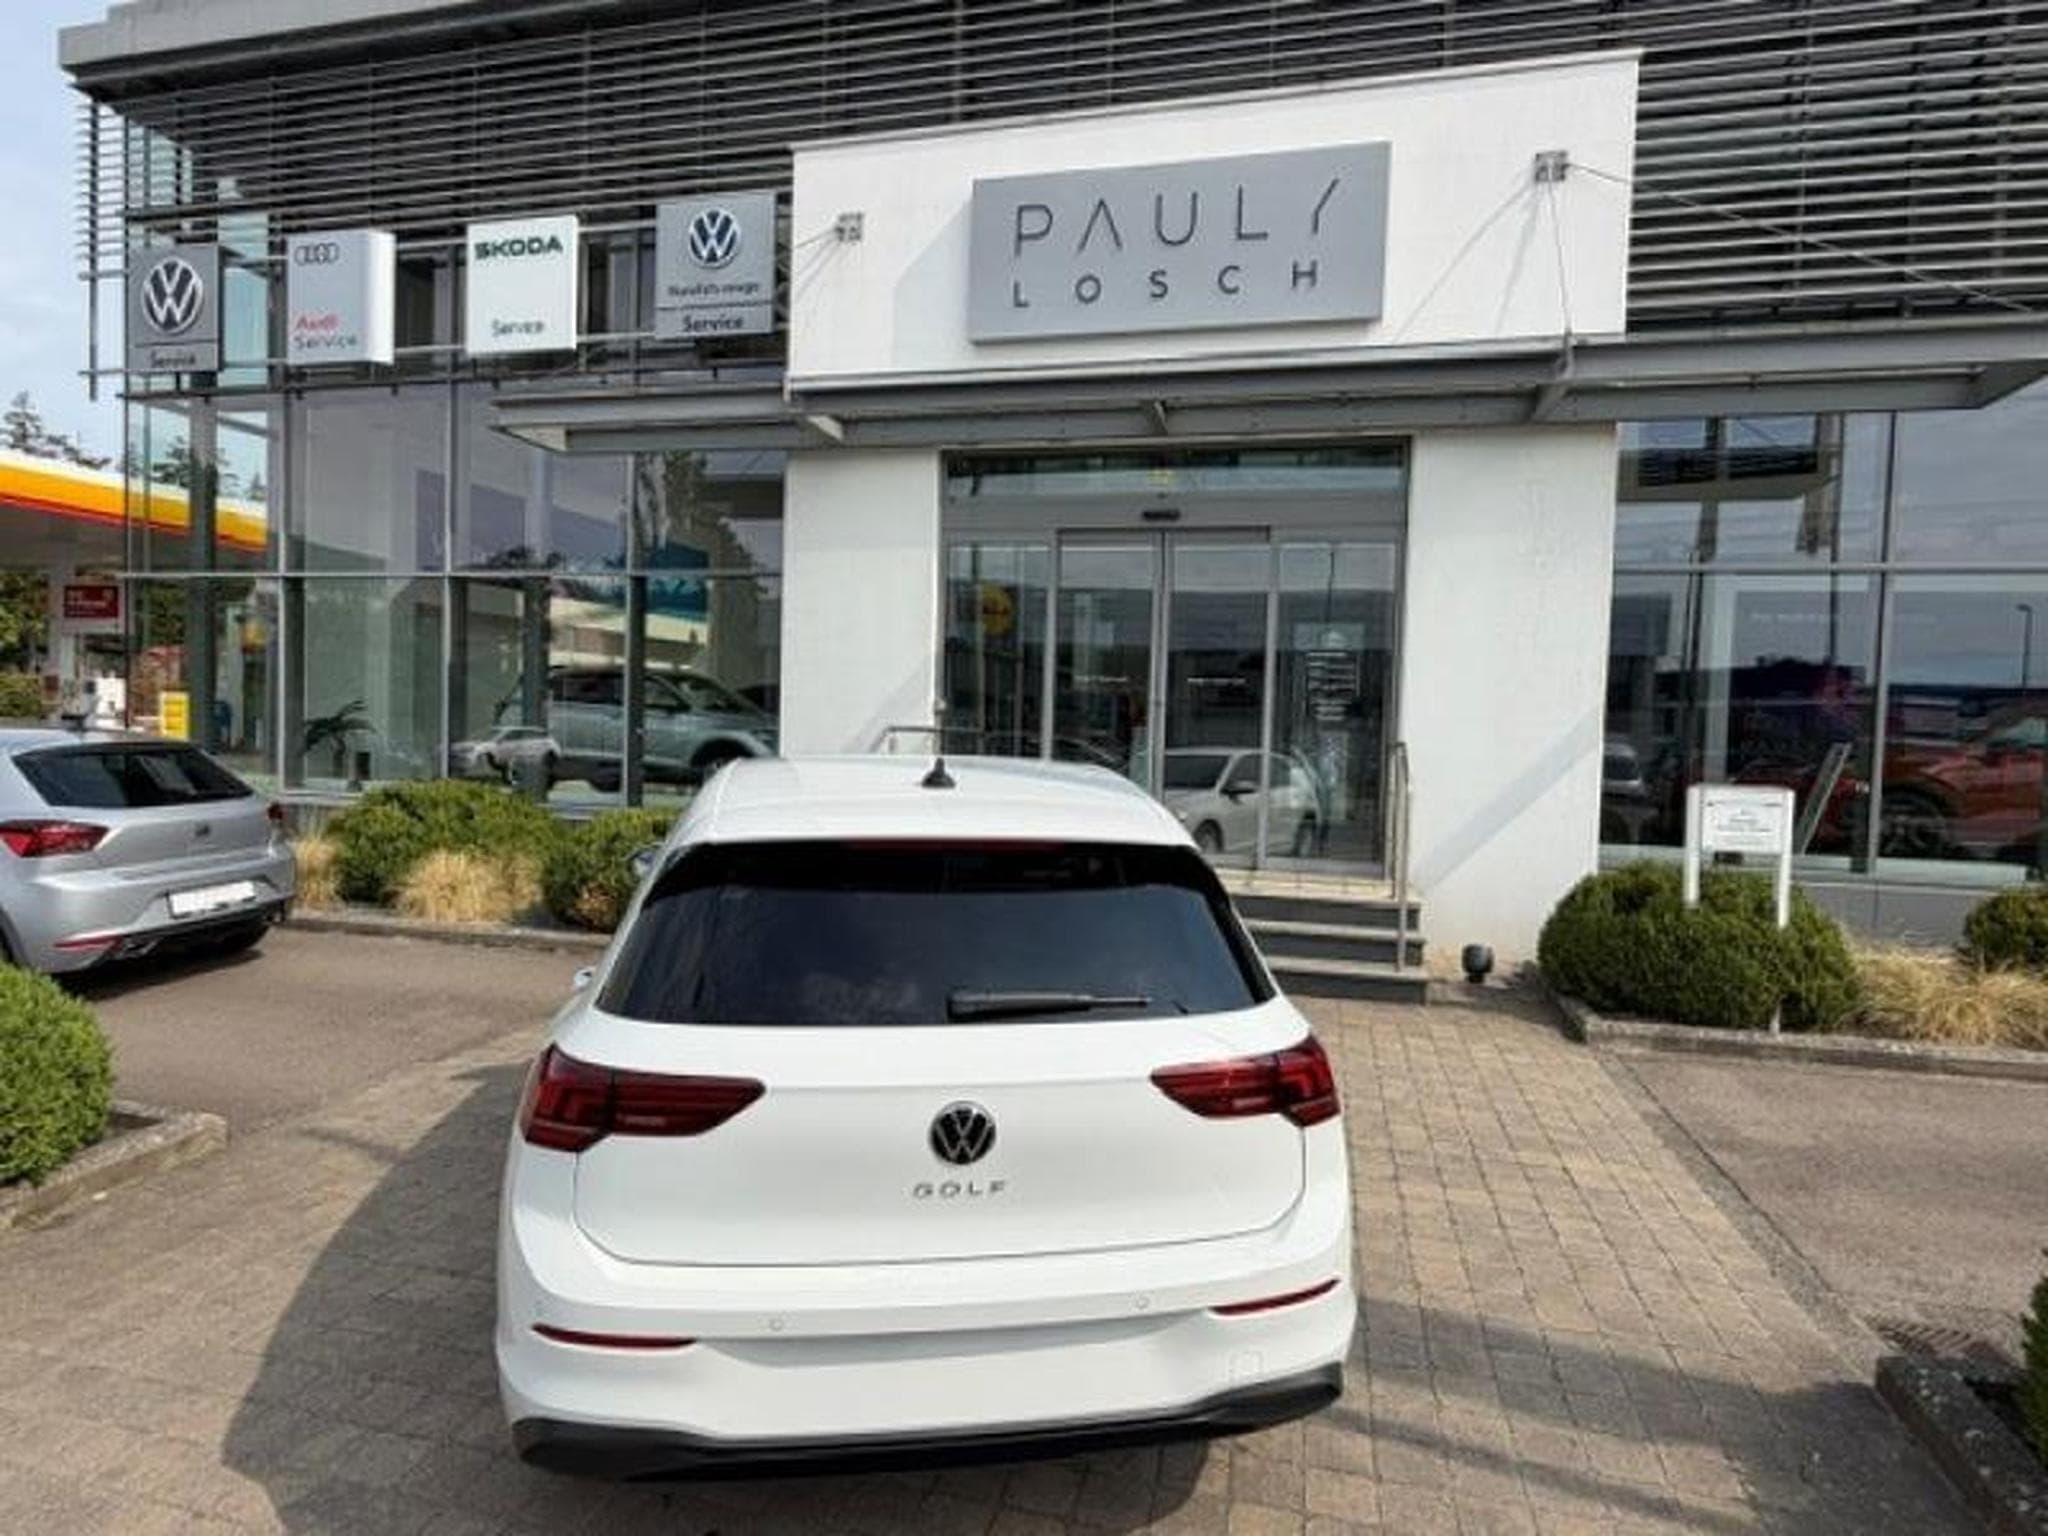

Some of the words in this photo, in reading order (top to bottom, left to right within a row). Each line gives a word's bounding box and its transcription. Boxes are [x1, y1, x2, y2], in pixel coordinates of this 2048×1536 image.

[1014, 178, 1341, 256] PAULY
[1013, 259, 1318, 308] LOSCH
[491, 319, 545, 337] Service
[682, 314, 744, 332] Service
[293, 334, 357, 350] Service
[912, 1179, 1007, 1199] GOLF
